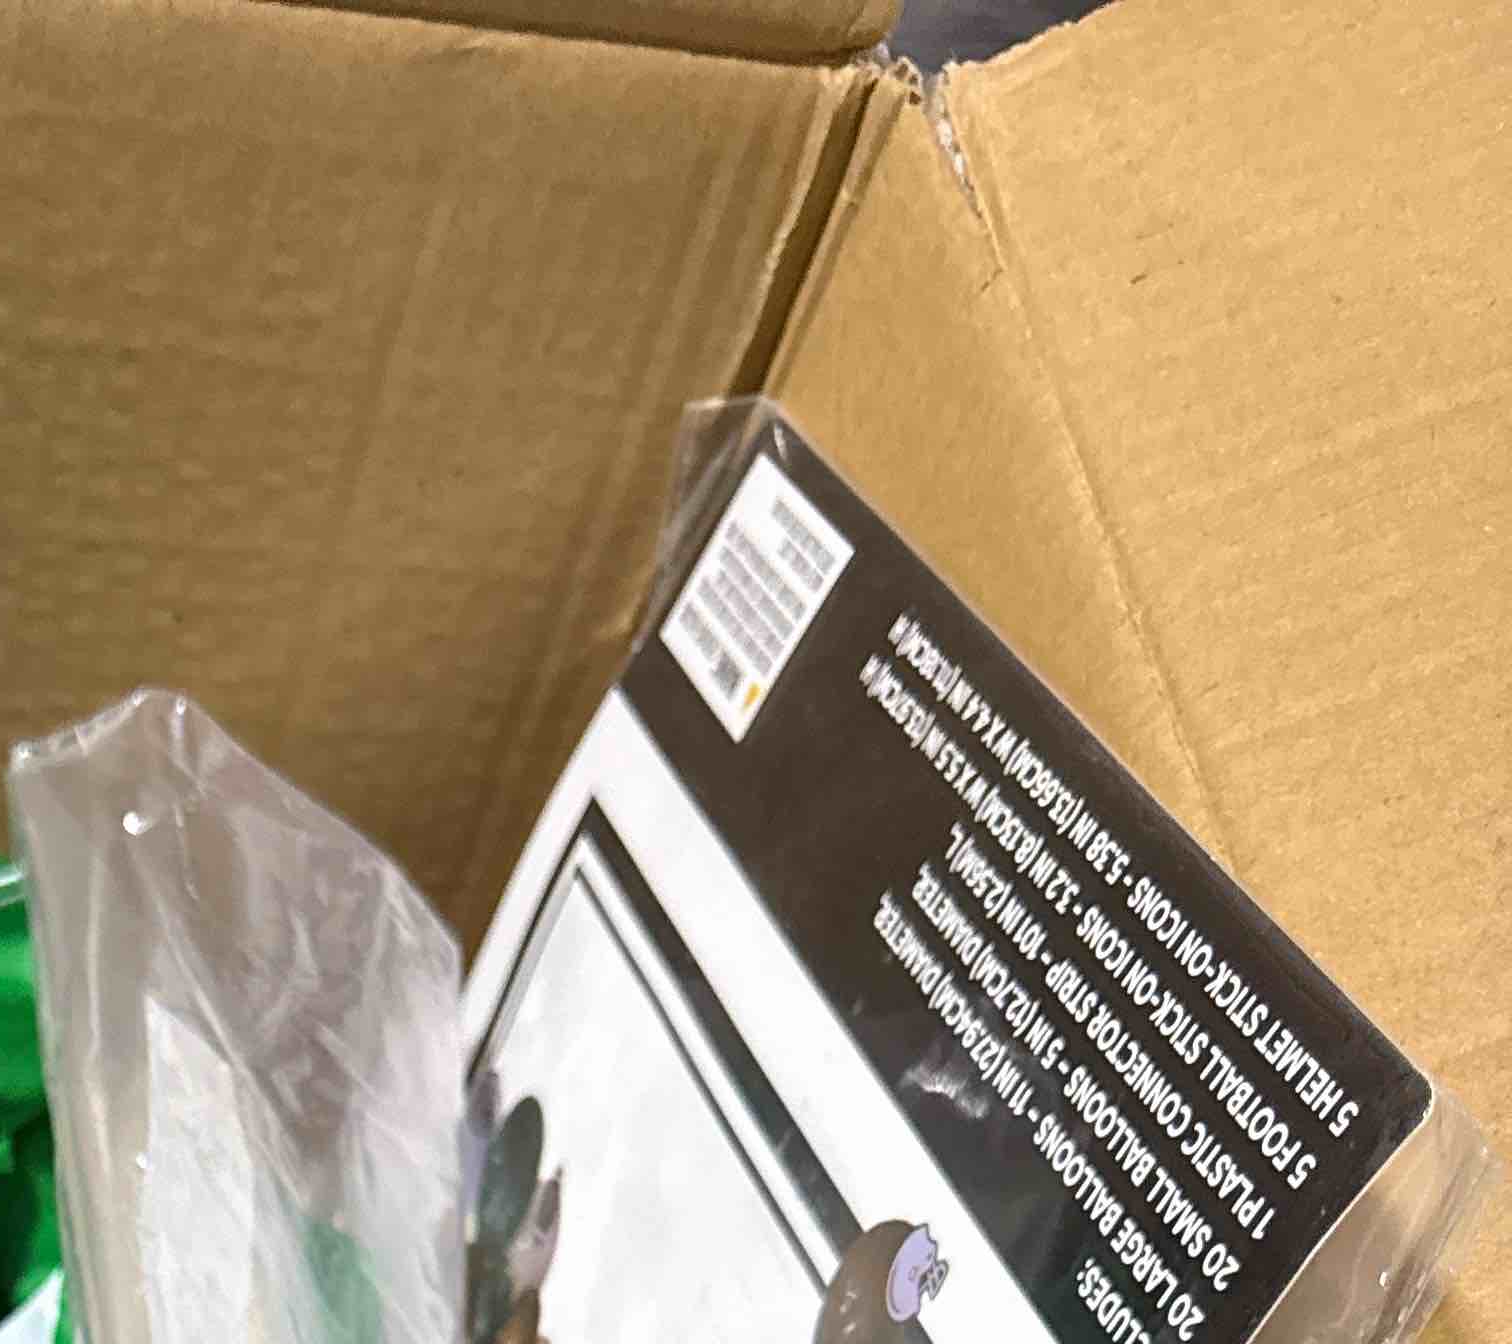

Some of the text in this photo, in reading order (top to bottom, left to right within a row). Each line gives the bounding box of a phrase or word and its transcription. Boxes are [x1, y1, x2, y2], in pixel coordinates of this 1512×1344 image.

[946, 677, 974, 713] IN
[961, 693, 992, 733] 4.4
[919, 725, 948, 761] IN
[980, 714, 1006, 749] X
[990, 728, 1018, 764] W
[934, 740, 966, 783] 5.5
[952, 762, 977, 795] X
[962, 775, 989, 810] W
[1003, 738, 1085, 835] (13.66CM)
[974, 786, 1045, 873] (8.13CM)
[1067, 811, 1099, 850] IN
[949, 836, 1013, 919] (2.56M)
[1027, 850, 1059, 889] IN
[1085, 830, 1131, 885] 5.38
[911, 863, 984, 966] DIAMETER,
[996, 895, 1027, 935] IN
[1044, 868, 1080, 915] 3.2
[1126, 876, 1189, 950] ICONS
[873, 891, 943, 995] DIAMETER,
[1012, 914, 1047, 961] 101
[1076, 905, 1135, 979] ICONS
[968, 943, 1041, 1038] (12.7CM)
[1045, 959, 1099, 1023] STRIP
[1173, 929, 1269, 1037] STICK-ON
[927, 972, 1009, 1081] (27.94CM)
[1023, 1015, 1054, 1056] IN
[1120, 958, 1210, 1065] STICK-ON
[1040, 1037, 1065, 1070] 5
[1086, 1004, 1193, 1138] CONNECTOR
[1253, 1020, 1344, 1120] HELMET
[991, 1057, 1022, 1100] IN
[1007, 1079, 1034, 1116] 11
[1063, 1065, 1157, 1187] BALLOONS
[1199, 1045, 1302, 1172] FOOTBALL
[1328, 1100, 1360, 1137] 5
[1032, 1113, 1124, 1237] BALLOONS
[1180, 1121, 1265, 1228] PLASTIC
[1286, 1153, 1317, 1190] 5
[1146, 1166, 1213, 1258] SMALL
[1251, 1208, 1275, 1240] 1
[1109, 1218, 1179, 1309] LARGE
[1202, 1243, 1240, 1292] 20
[1167, 1293, 1206, 1342] 20
